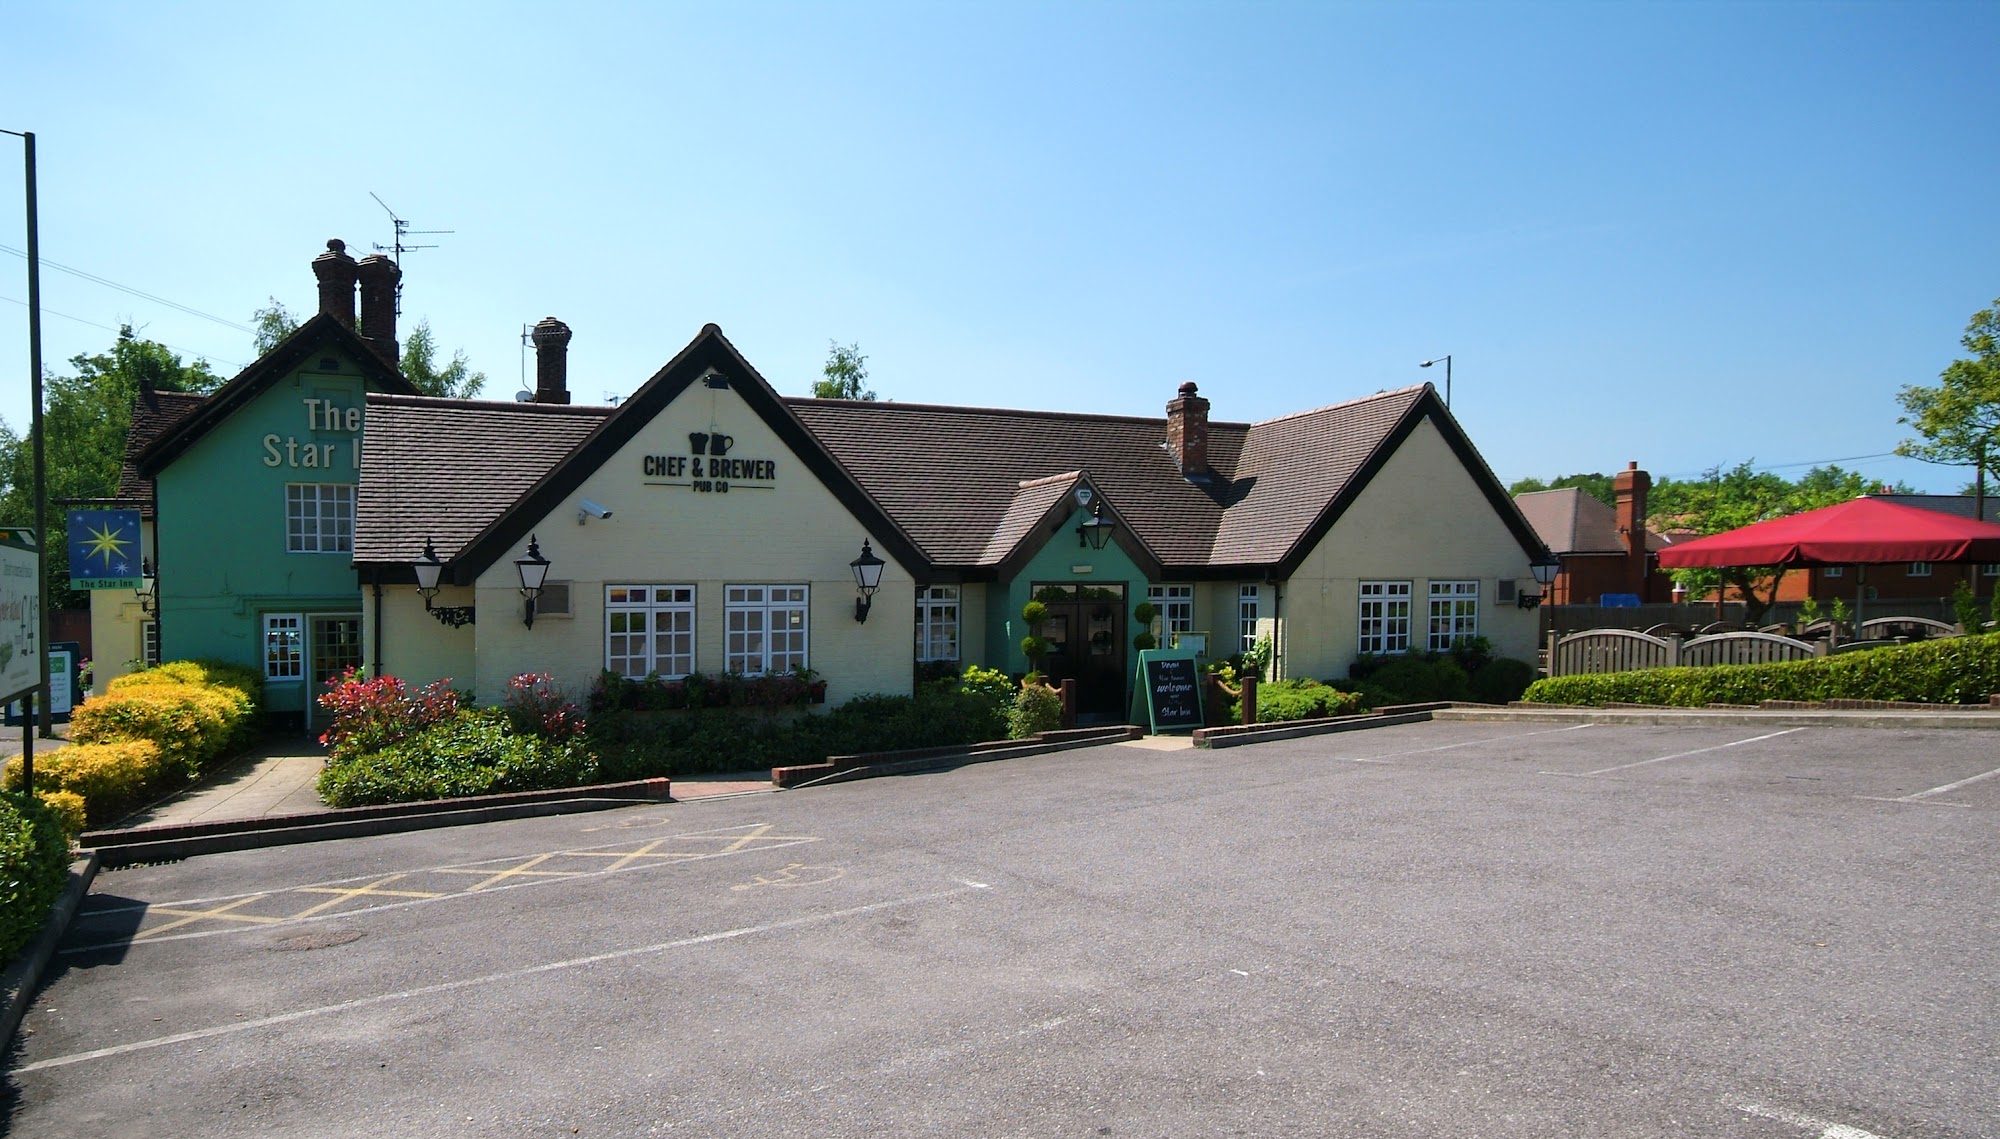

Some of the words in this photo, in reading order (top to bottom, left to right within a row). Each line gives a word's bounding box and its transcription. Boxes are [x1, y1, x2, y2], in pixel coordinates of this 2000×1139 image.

[303, 398, 361, 432] The
[263, 434, 335, 468] Star
[643, 455, 687, 477] CHEF
[692, 457, 704, 478] &
[709, 458, 776, 480] BREWER
[693, 480, 712, 493] PUB
[715, 481, 729, 493] CO
[80, 580, 95, 588] The
[98, 580, 116, 588] Star
[120, 579, 133, 587] Inn
